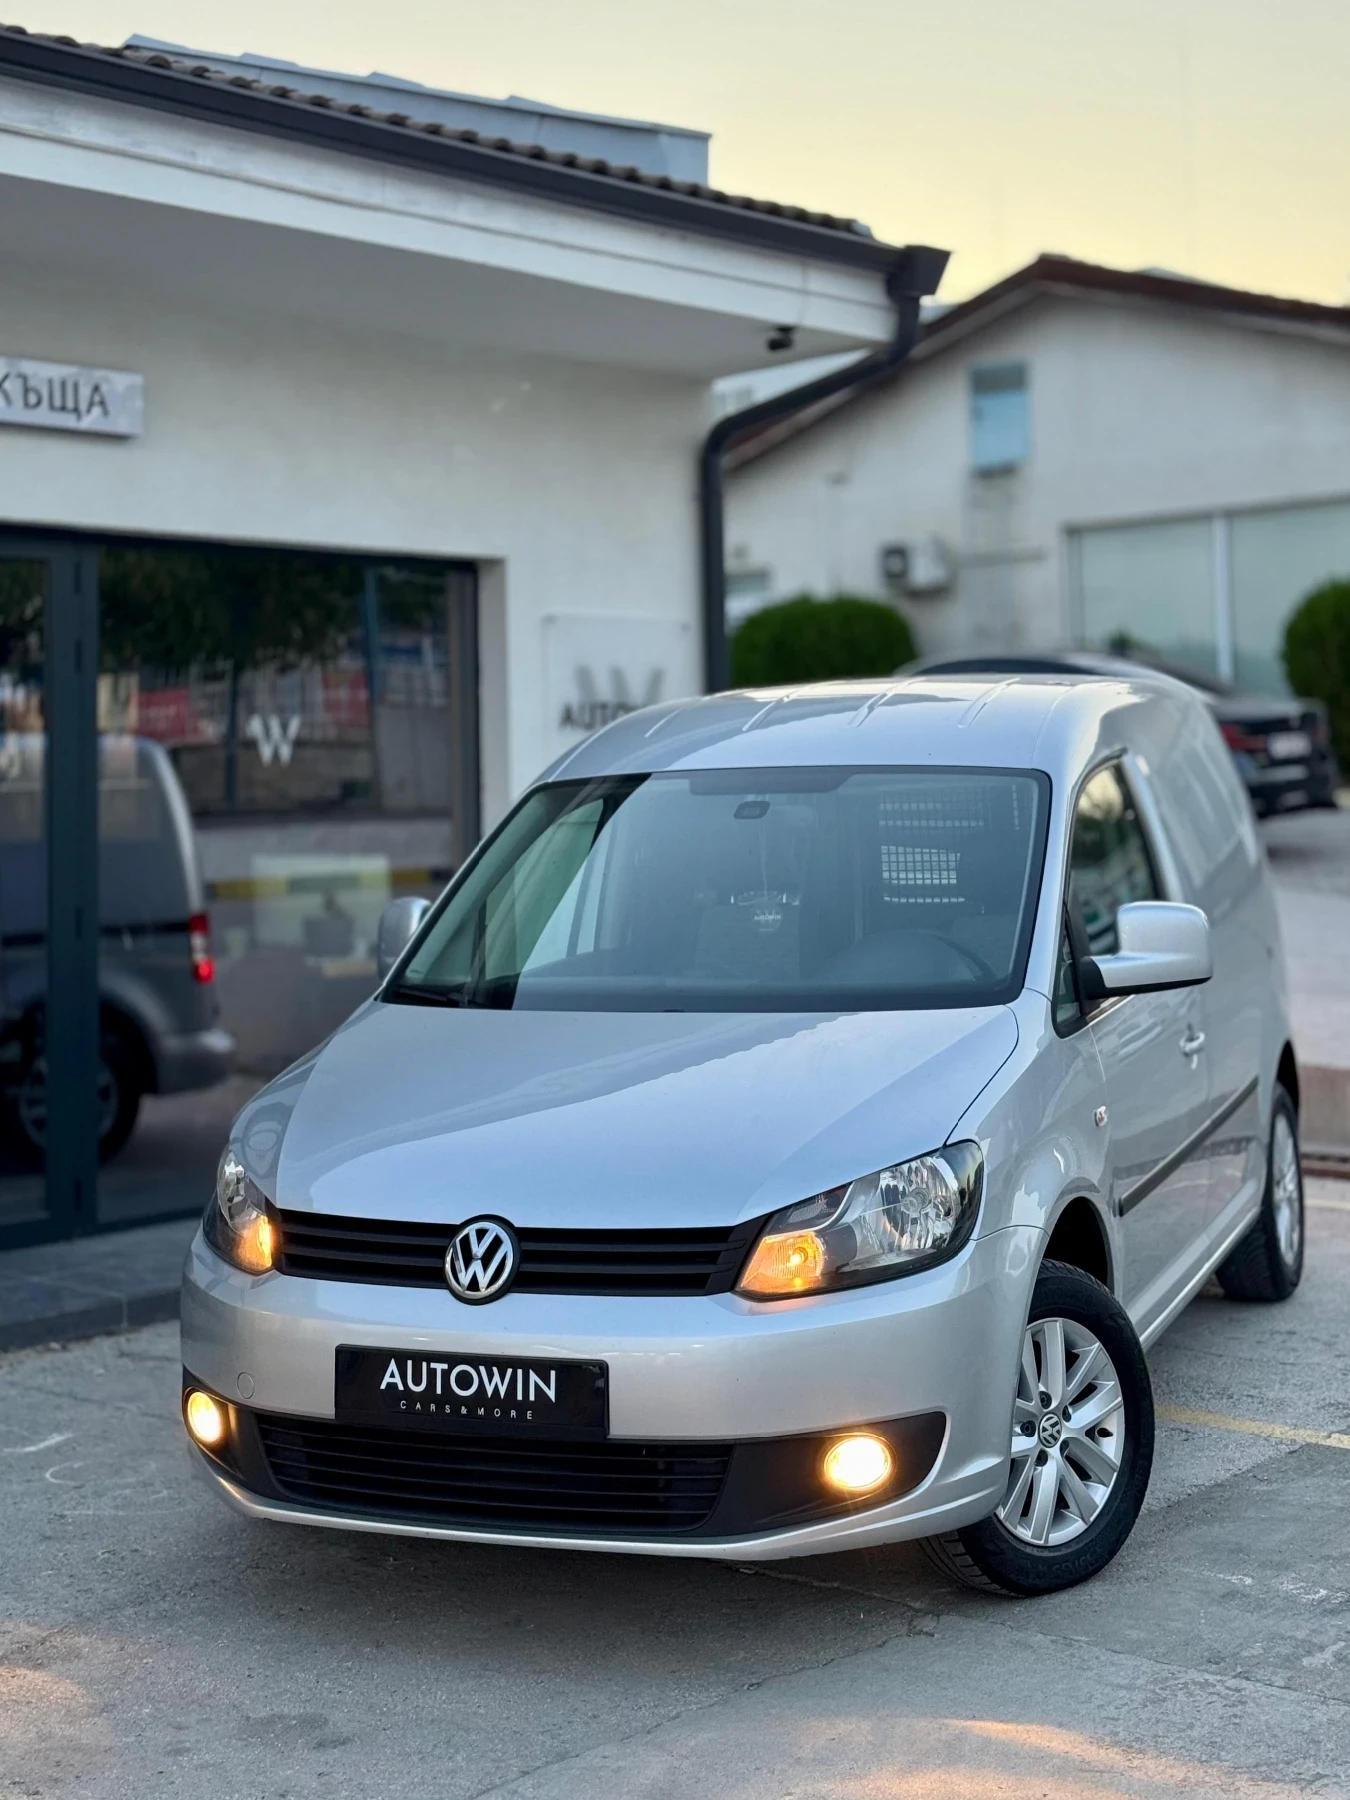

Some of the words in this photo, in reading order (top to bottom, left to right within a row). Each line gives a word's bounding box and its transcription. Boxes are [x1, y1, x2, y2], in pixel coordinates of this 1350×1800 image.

[249, 713, 301, 768] W
[446, 1223, 512, 1298] VW
[380, 1358, 556, 1403] AUTOWIN
[400, 1400, 533, 1420] CARS&MORE
